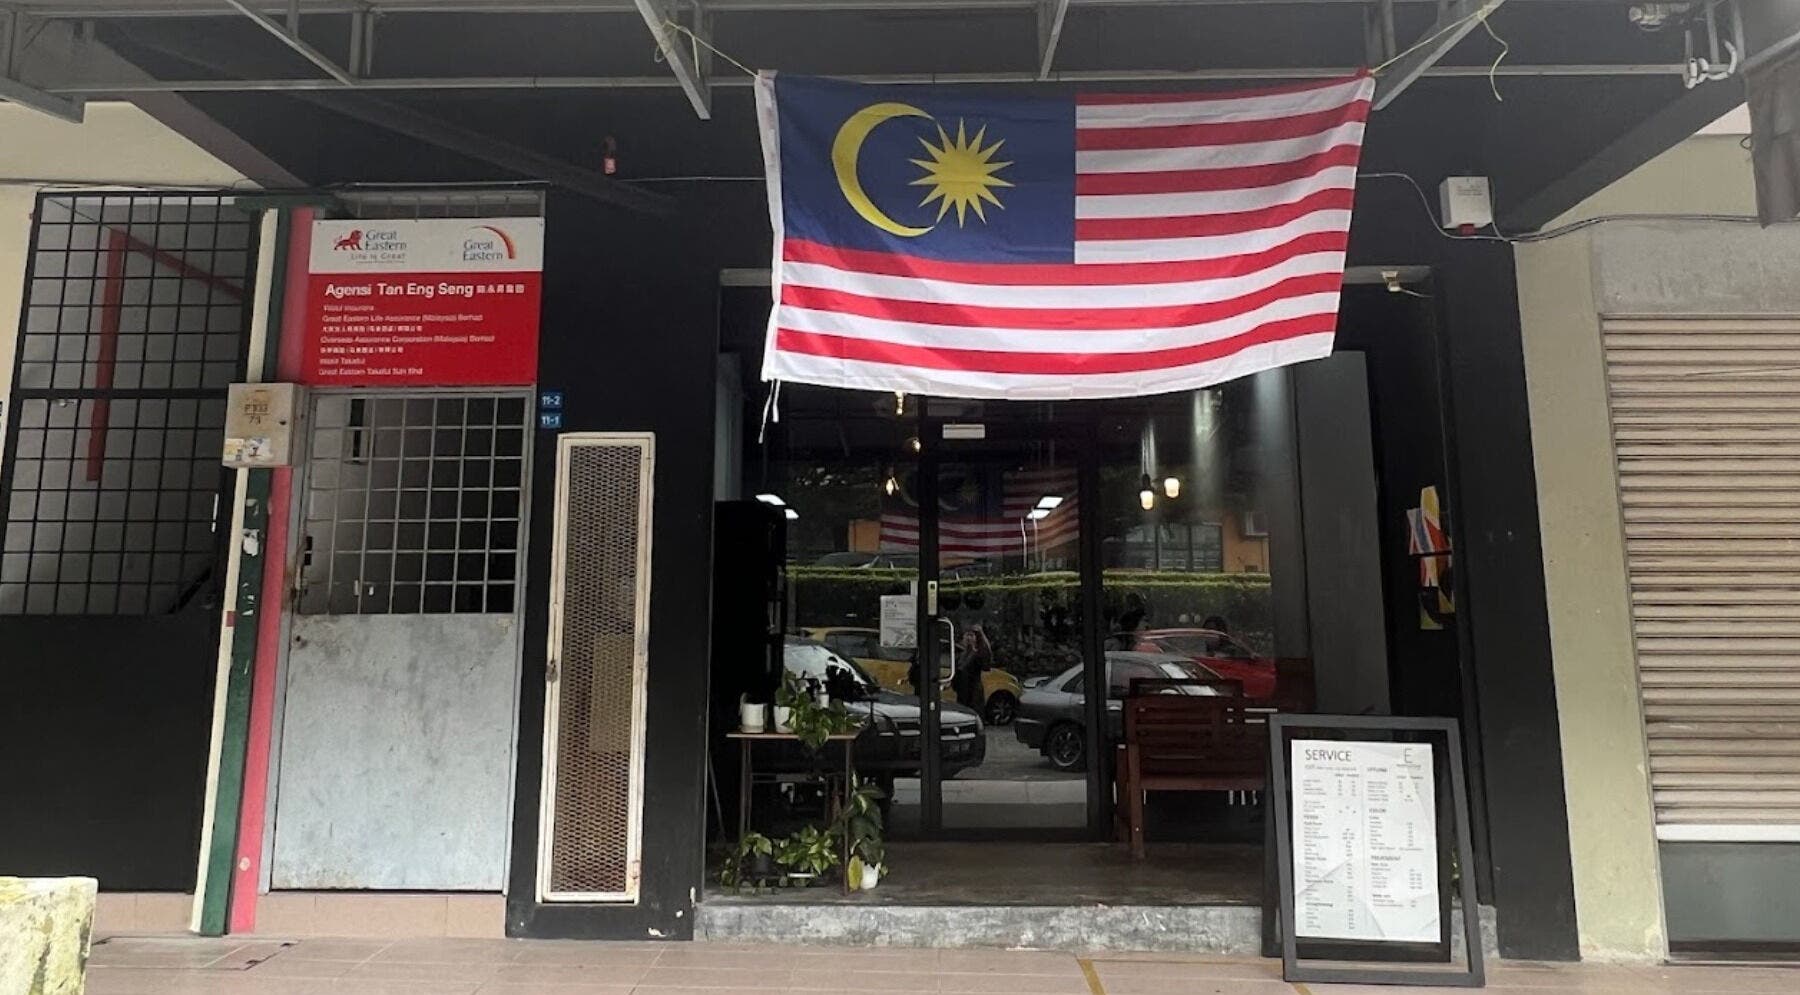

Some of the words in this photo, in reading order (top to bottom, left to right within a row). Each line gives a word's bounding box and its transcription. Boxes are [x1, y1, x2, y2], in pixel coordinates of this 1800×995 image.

[366, 230, 397, 241] Great
[365, 240, 407, 251] Eastern
[463, 239, 493, 250] Great
[463, 250, 503, 262] Eastern
[325, 284, 372, 298] Agensi
[377, 283, 403, 295] Tan
[407, 283, 434, 298] Eng
[438, 282, 474, 298] Seng
[542, 395, 560, 405] 11-2
[542, 415, 560, 425] 11-1
[1305, 749, 1352, 762] SERVICE
